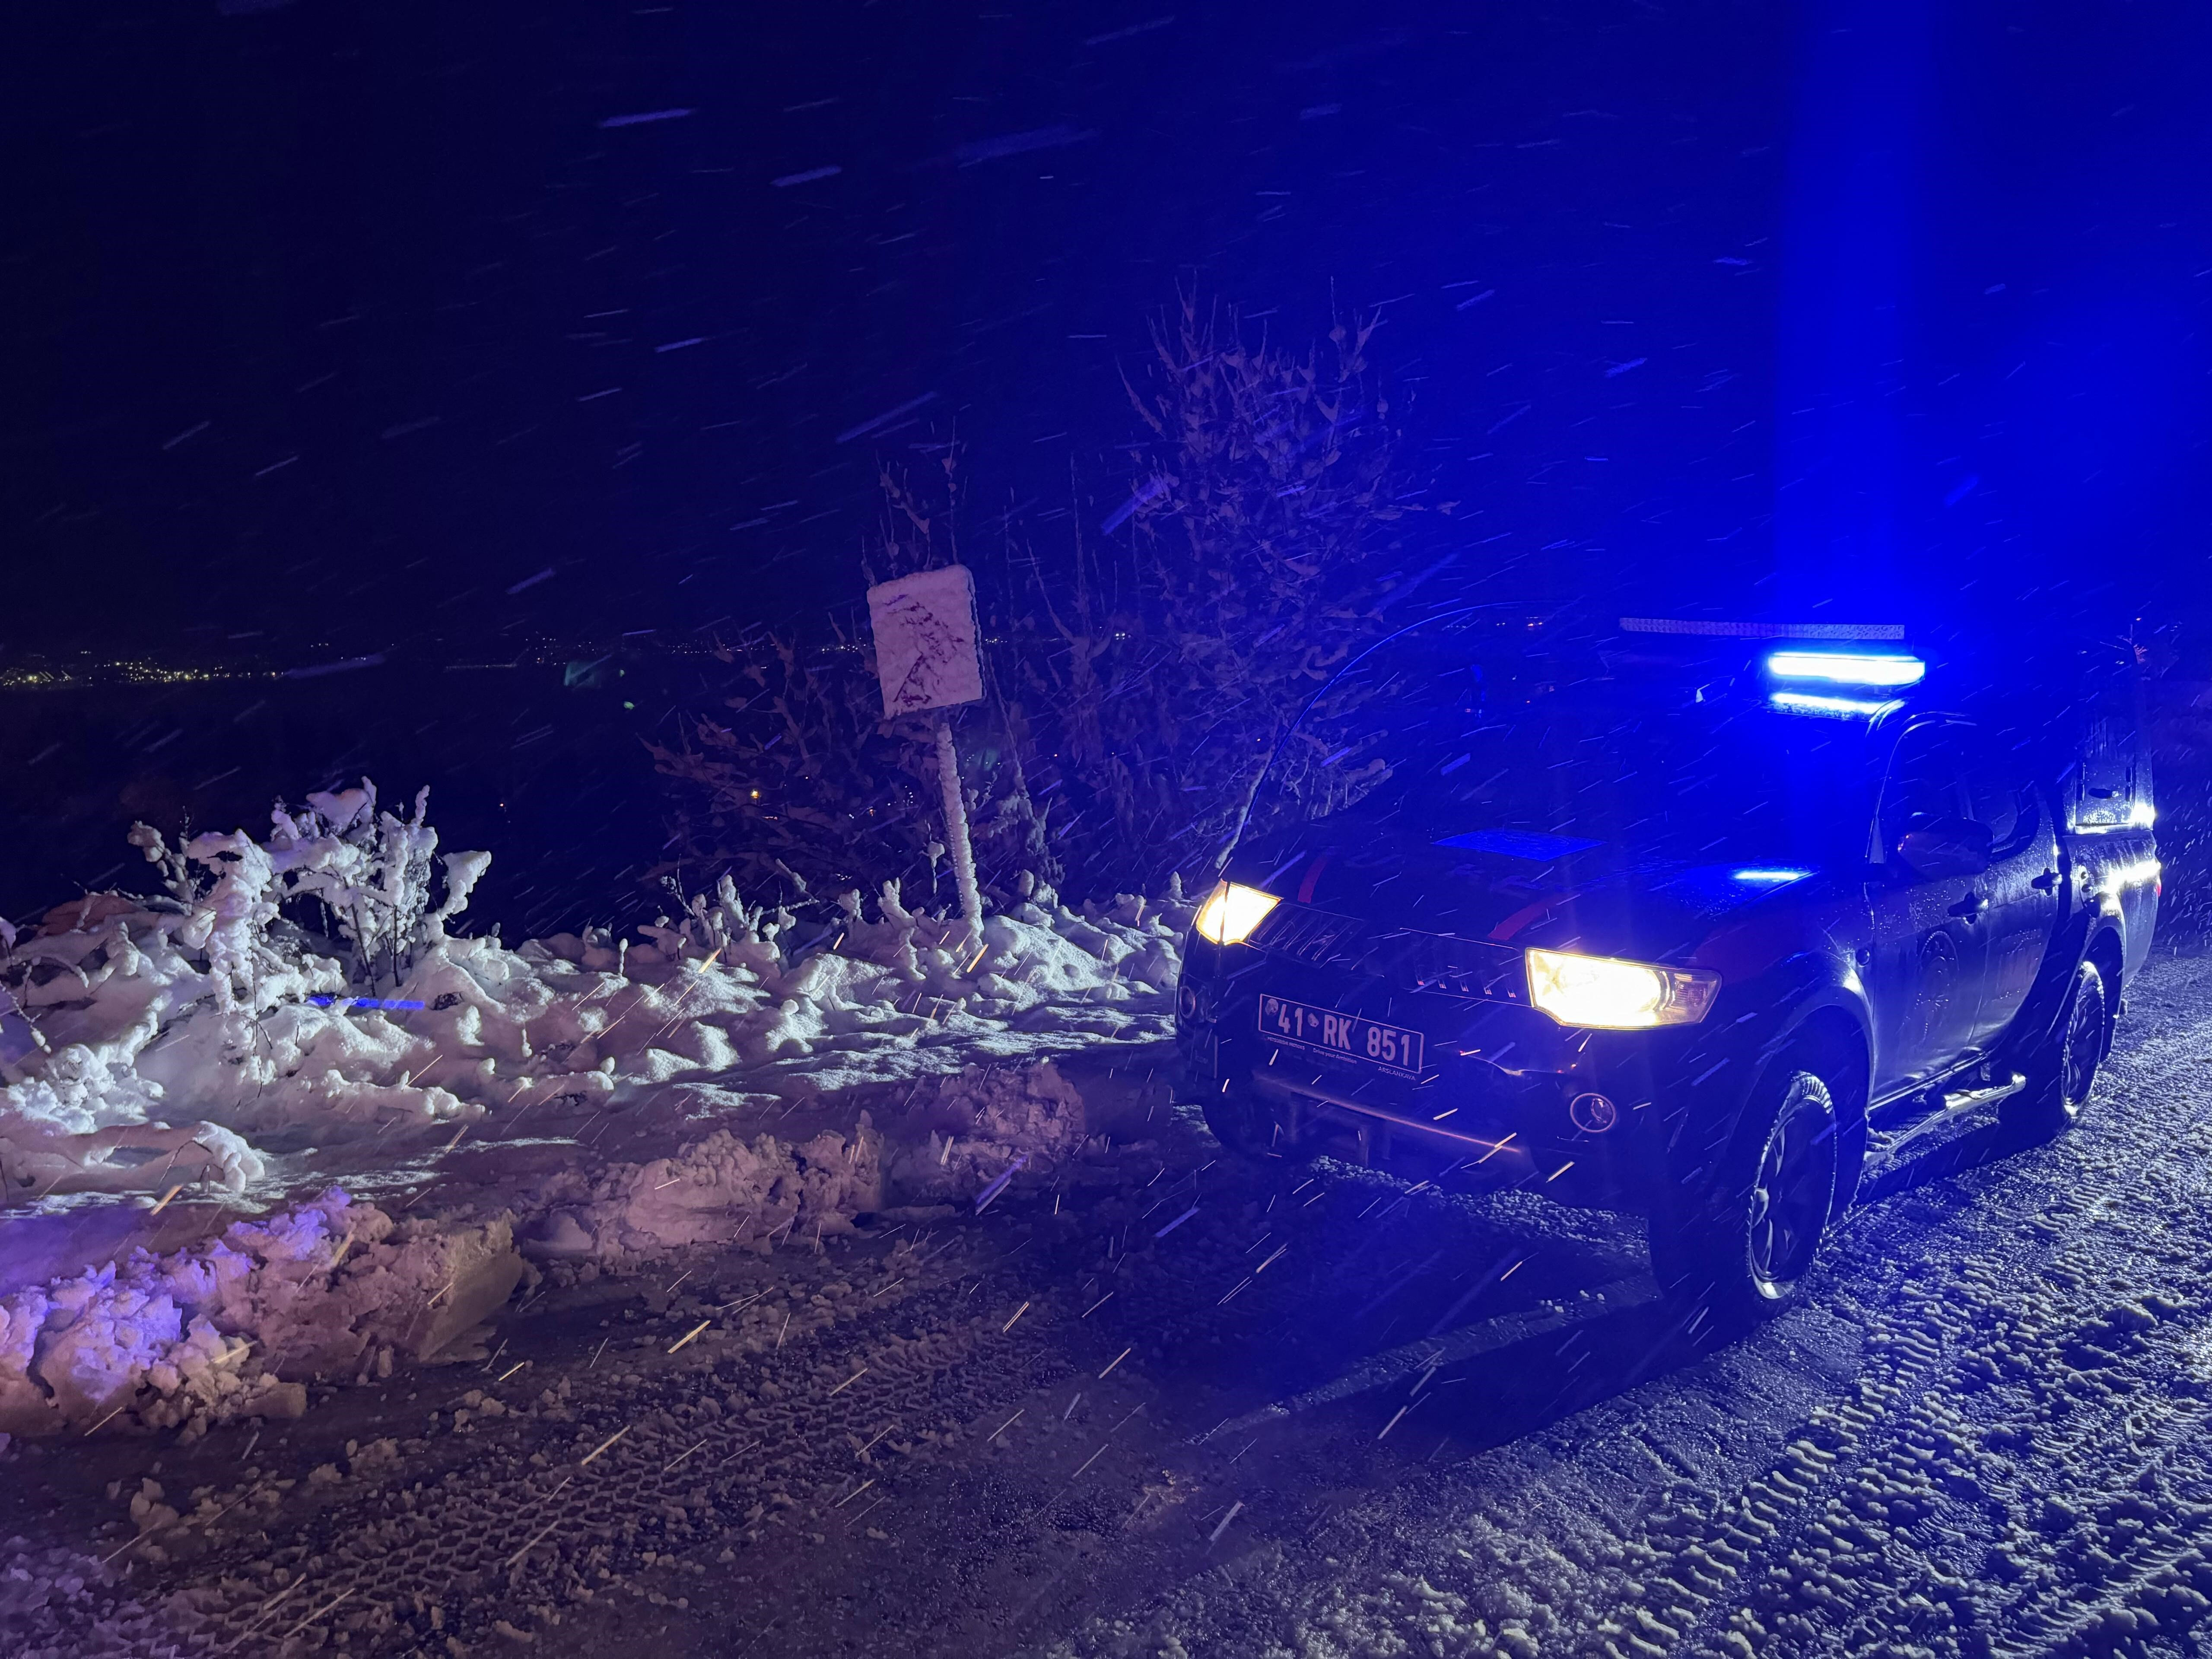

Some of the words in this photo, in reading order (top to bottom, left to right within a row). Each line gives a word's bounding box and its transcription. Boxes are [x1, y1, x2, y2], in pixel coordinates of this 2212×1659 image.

[1278, 1004, 1303, 1036] 41
[1323, 1014, 1352, 1050] RK
[1367, 1027, 1410, 1066] 851
[1378, 1066, 1416, 1080] ARSLANKAYA
